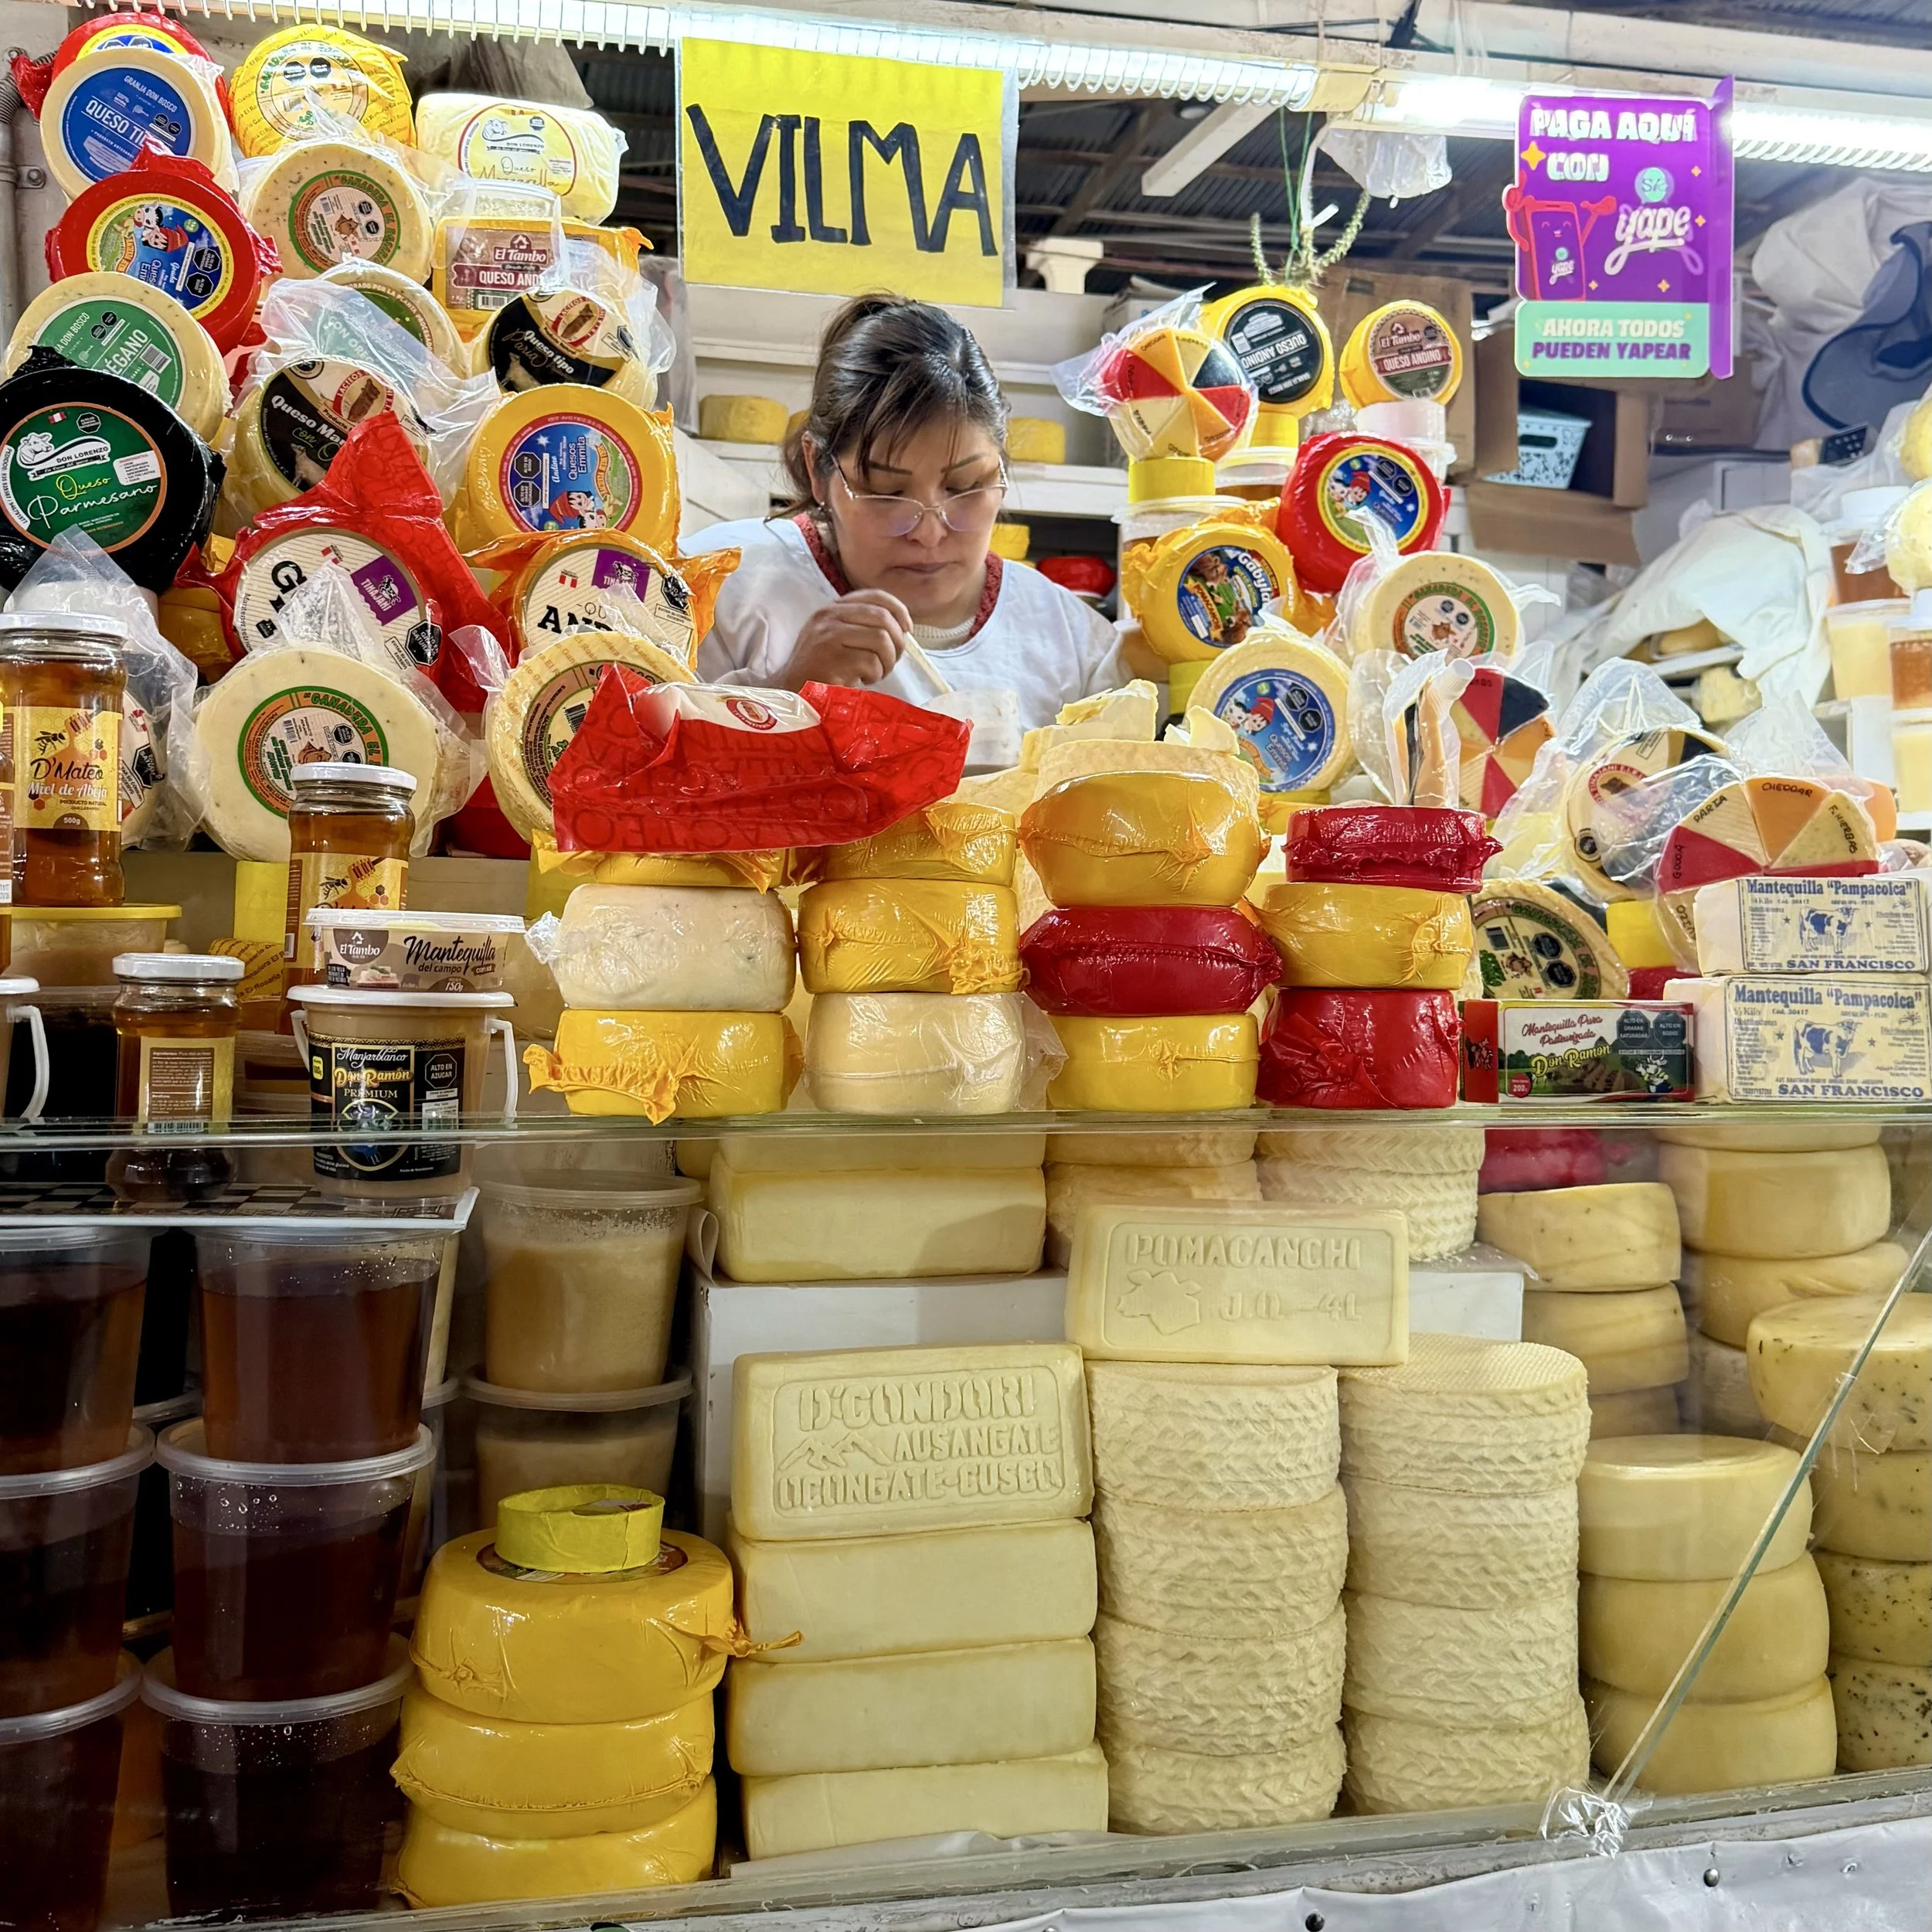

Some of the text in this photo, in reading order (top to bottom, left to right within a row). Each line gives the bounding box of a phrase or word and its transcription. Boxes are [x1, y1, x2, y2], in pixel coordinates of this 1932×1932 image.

[124, 75, 147, 94] GRANJA
[145, 88, 159, 101] DON
[157, 97, 178, 113] BOSCO
[85, 99, 131, 134] QUESO
[1530, 109, 1612, 141] PAGA
[501, 156, 536, 175] Queso
[1546, 152, 1610, 182] CON
[685, 104, 998, 256] VILMA
[1604, 205, 1692, 275] yape
[495, 249, 546, 262] El Tambo
[479, 270, 515, 285] QUESO
[372, 283, 418, 315] POR LA PLANTA
[60, 330, 75, 347] DON
[72, 311, 90, 335] BOSCO
[1543, 318, 1684, 338] AHORA TODOS
[502, 328, 549, 368] Paria
[1241, 333, 1308, 369] QUESO ANDINO
[1380, 332, 1421, 348] El Tambo
[1532, 342, 1692, 361] PUEDEN YAPEAR
[524, 330, 574, 375] Queso tipo
[1383, 349, 1442, 370] QUESO ANDINO
[270, 395, 317, 429] Queso
[321, 408, 349, 430] Producto
[74, 447, 109, 459] LORENZO
[568, 442, 577, 481] Quesos
[577, 436, 587, 474] Emmita
[550, 455, 560, 483] Andino
[56, 474, 111, 501] Queso
[27, 485, 158, 529] Parmesano
[367, 740, 381, 756] EL
[29, 782, 107, 800] Miel de Abeja
[1762, 782, 1814, 798] CHEDDAR
[1693, 794, 1727, 823] PARIA
[63, 817, 81, 825] 500g
[1747, 879, 1824, 897] Mantequilla
[270, 954, 279, 963] El
[339, 942, 381, 956] El Tambo
[403, 934, 496, 976] Mantequilla
[418, 963, 462, 975] del campo
[1787, 959, 1916, 970] SAN FRANCISCO
[253, 973, 281, 989] Rosario
[1733, 985, 1823, 1008] Mantequilla
[1522, 1013, 1604, 1037] Mantequilla Pura
[1539, 1029, 1597, 1048] Pasteurizada
[336, 1046, 409, 1069] Manjarblanco
[1530, 1053, 1563, 1078] Don
[333, 1067, 413, 1088] Don Ramón
[430, 1070, 453, 1080] AZUCAR
[343, 1088, 398, 1099] PREMIUM
[1777, 1084, 1924, 1097] SAN FRANCISCO
[1126, 1233, 1362, 1271] POMACANCHI
[894, 1423, 1060, 1463] AUSANGATE
